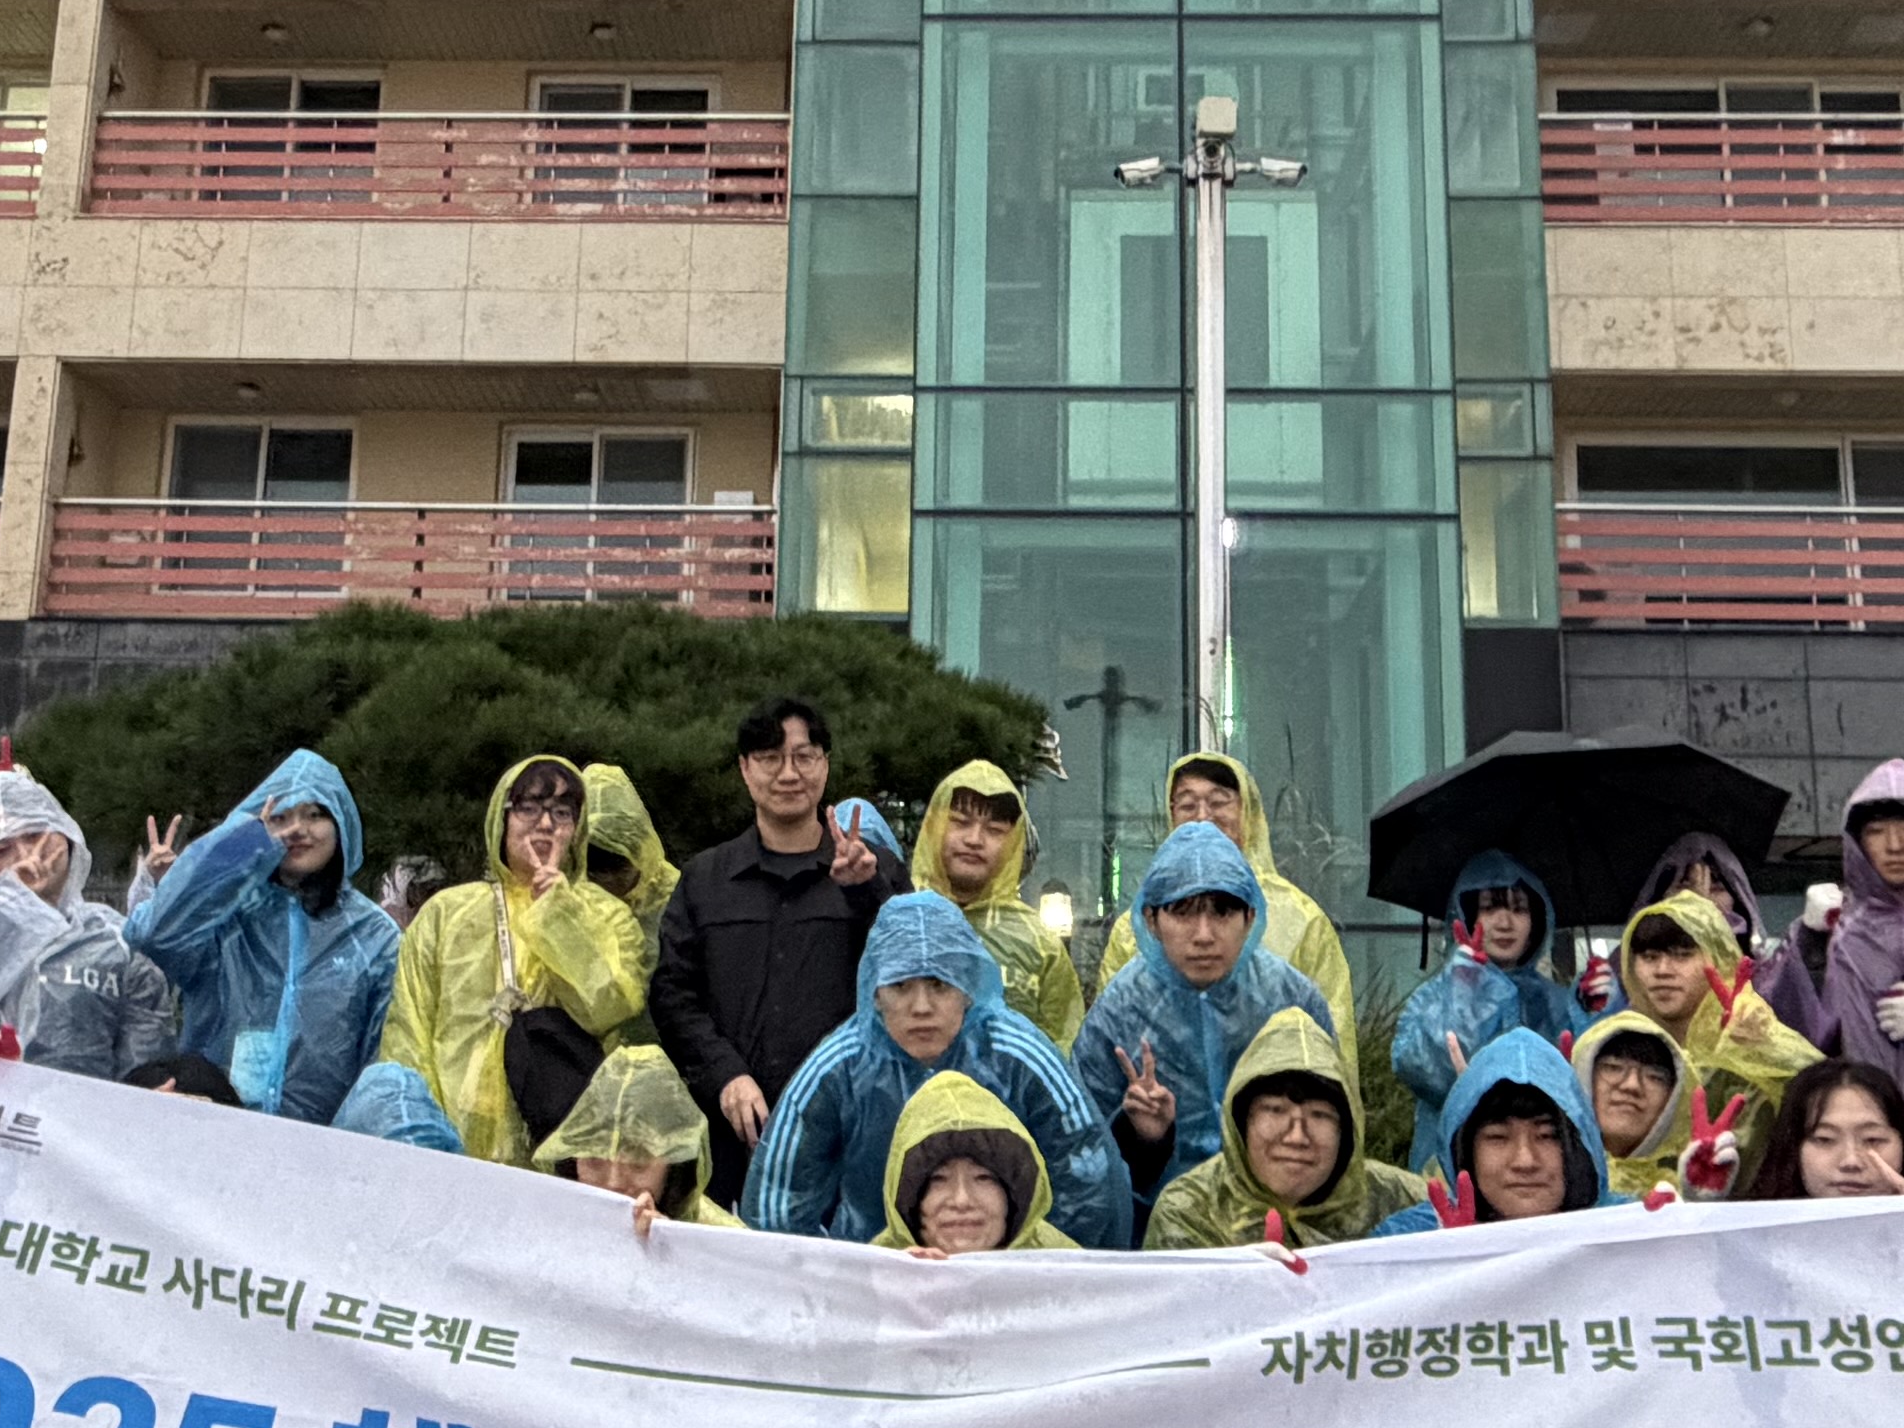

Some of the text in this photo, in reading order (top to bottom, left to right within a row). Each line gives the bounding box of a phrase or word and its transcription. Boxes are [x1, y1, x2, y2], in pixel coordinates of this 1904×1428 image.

[63, 964, 121, 998] LGA
[162, 1255, 305, 1332] 사다리
[312, 1290, 521, 1369] 프로젝트
[1259, 1317, 1569, 1385] 자치행정학과
[1584, 1317, 1635, 1374] 및
